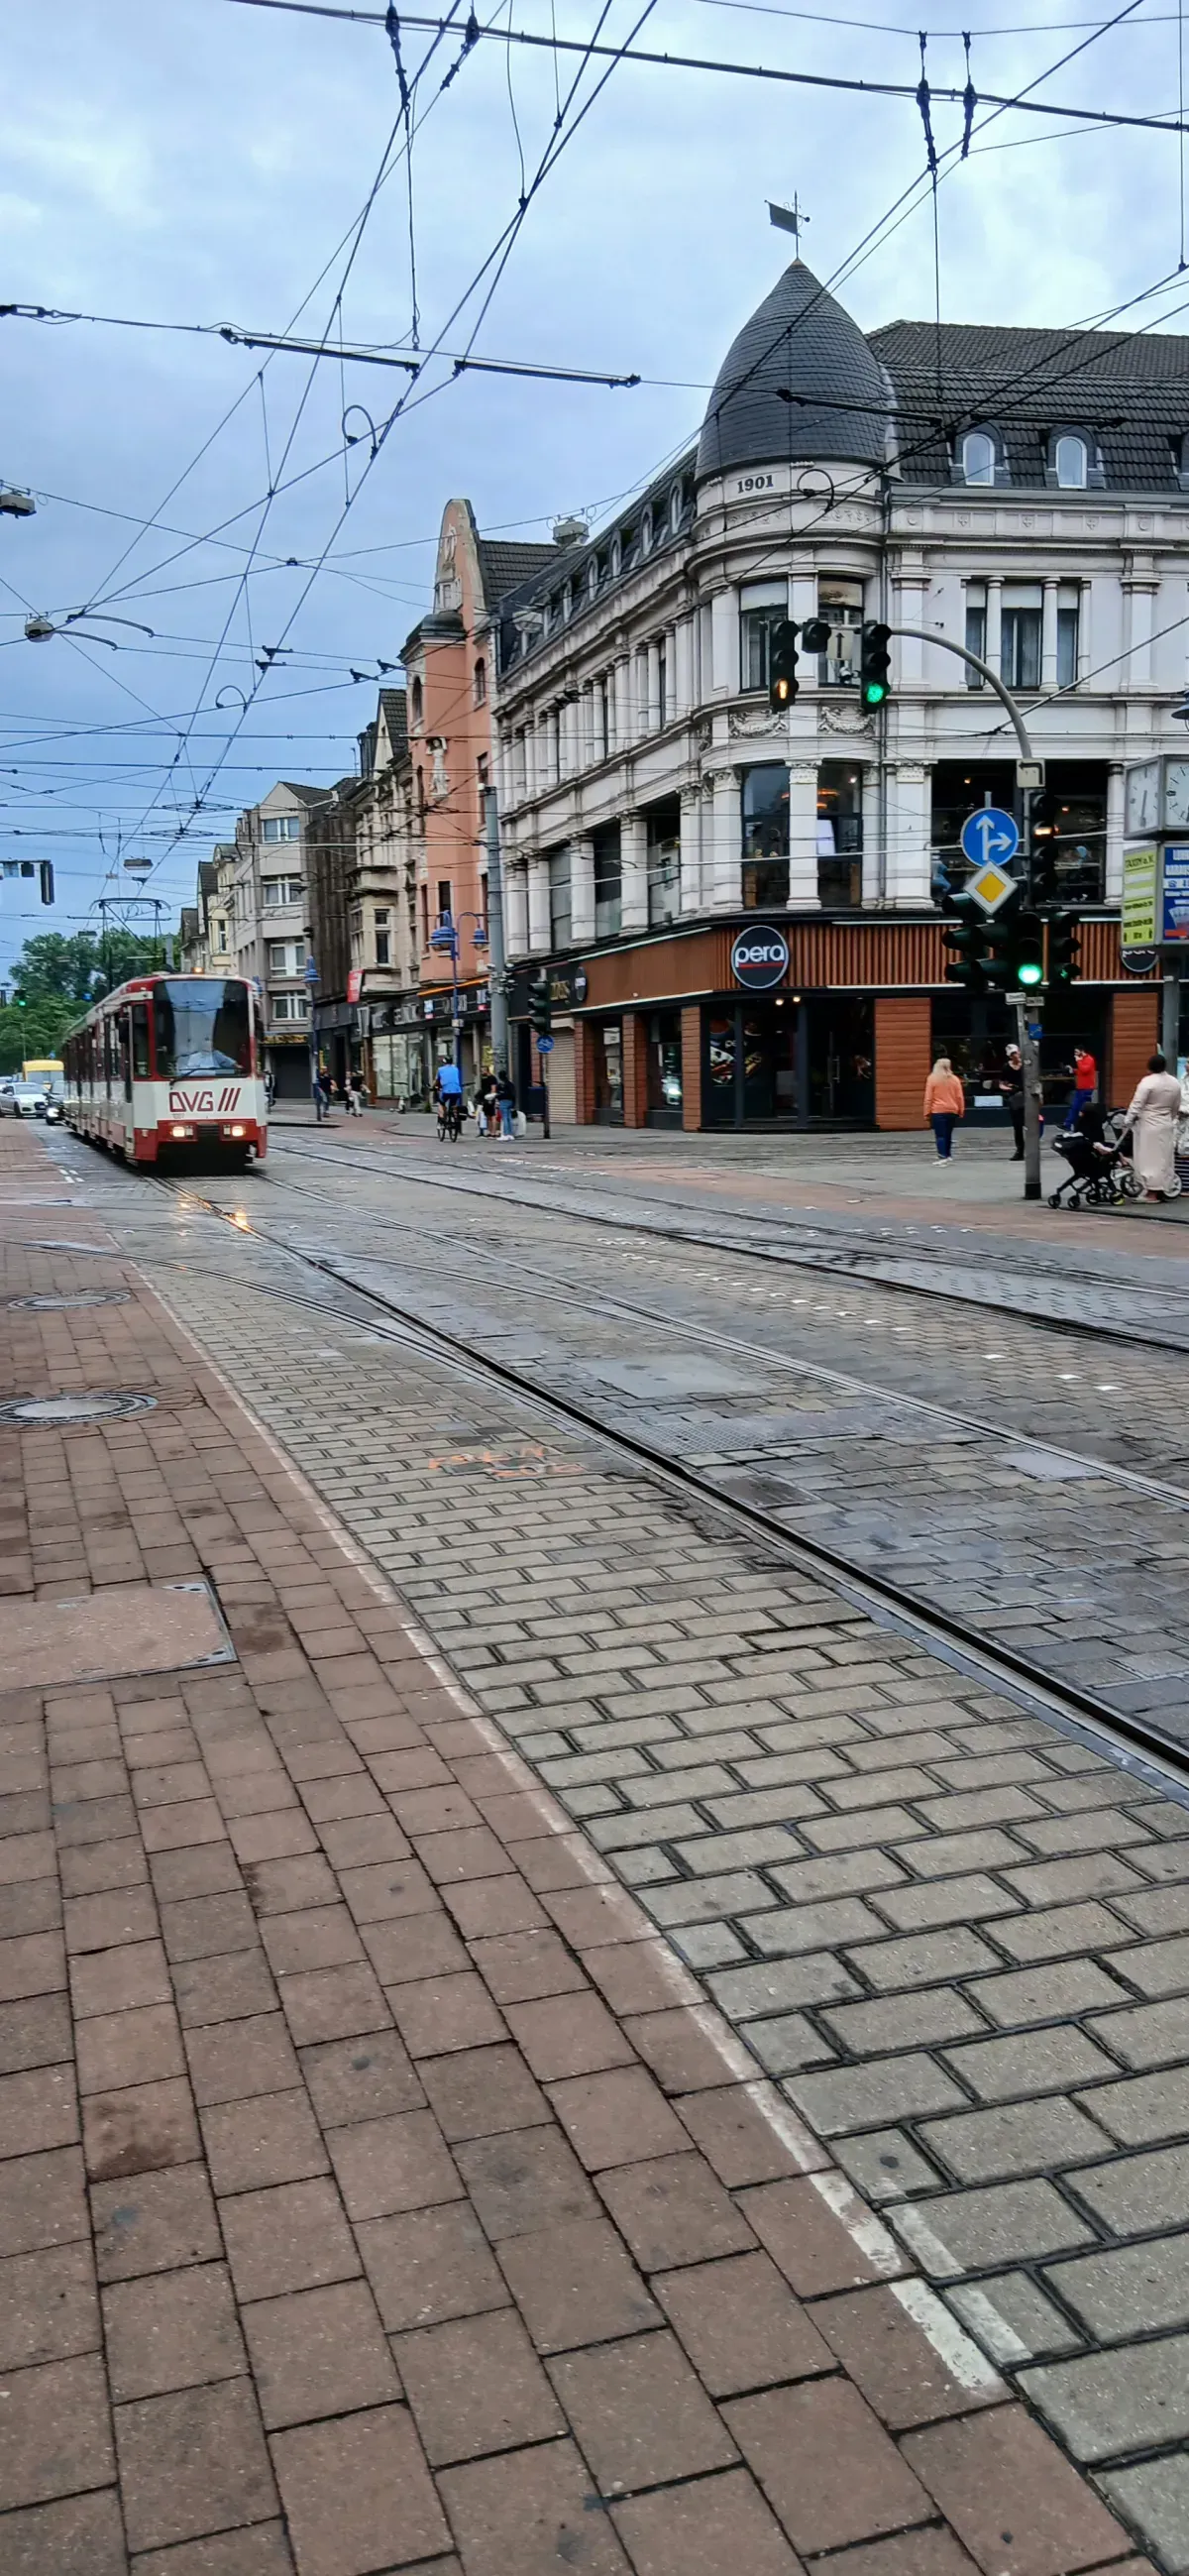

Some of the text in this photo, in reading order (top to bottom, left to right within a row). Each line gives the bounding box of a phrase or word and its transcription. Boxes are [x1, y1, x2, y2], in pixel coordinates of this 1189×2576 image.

[737, 475, 774, 494] 1901
[735, 945, 785, 968] pera
[168, 1091, 214, 1112] DVG
